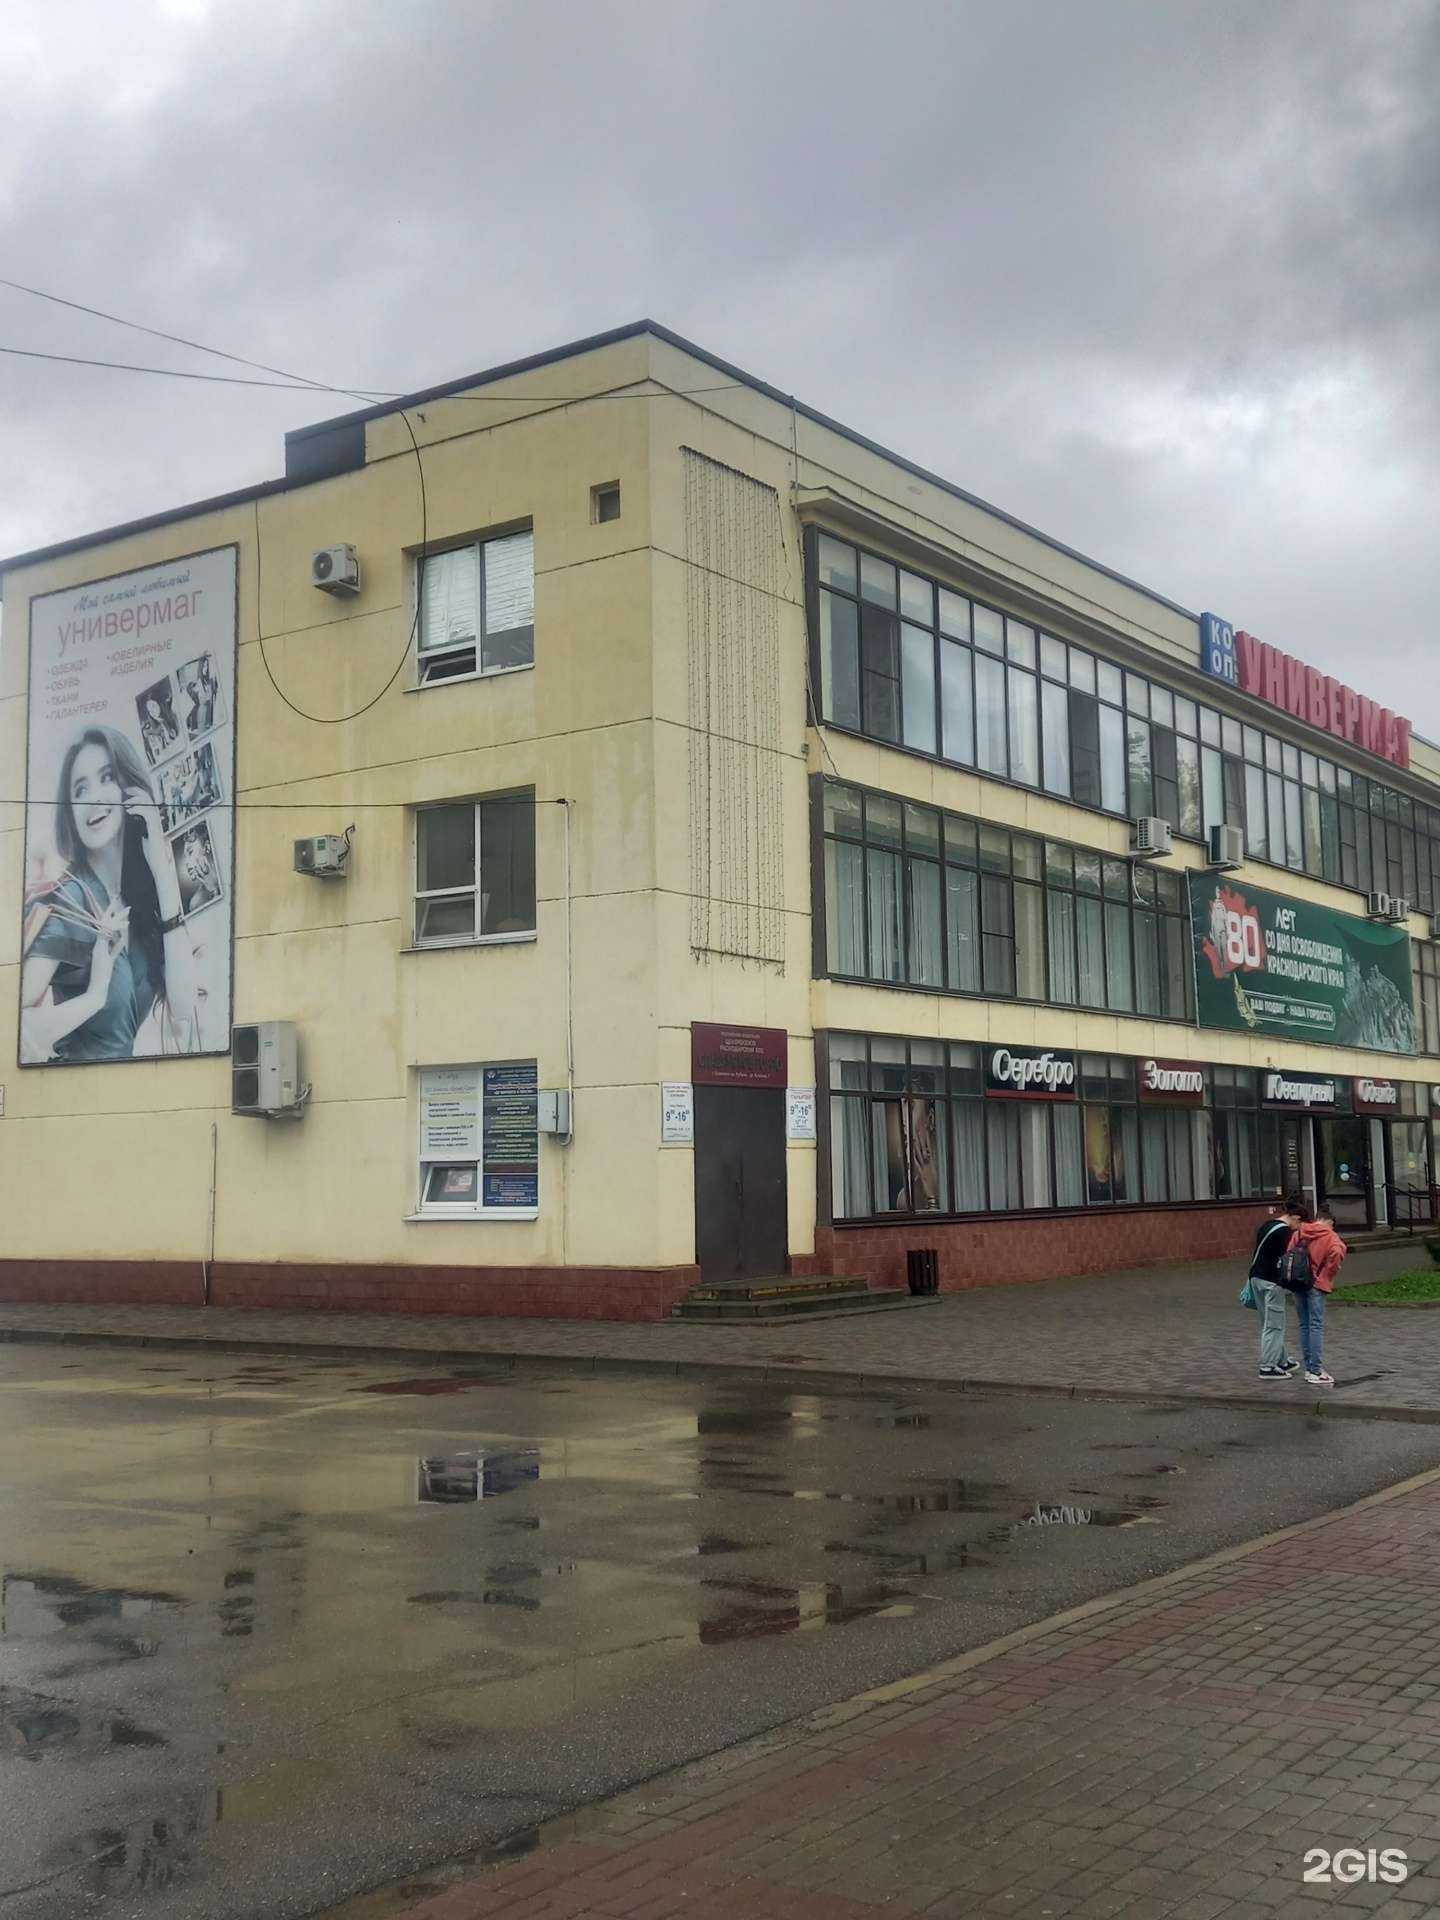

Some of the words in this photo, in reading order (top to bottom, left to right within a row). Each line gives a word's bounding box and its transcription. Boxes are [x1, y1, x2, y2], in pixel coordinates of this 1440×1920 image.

[58, 590, 203, 657] универмаг
[110, 638, 173, 662] ЮВЕЛИРНЫЕ
[50, 658, 88, 677] ОДЕЖДА
[110, 659, 154, 677] ИЗДЕЛИЯ
[50, 677, 80, 692] ОБУВЬ
[50, 692, 79, 707] ТКАНИ
[50, 700, 108, 720] ГАЛАНТЕРЕЯ
[1235, 630, 1412, 770] УНИВЕРМАГ
[1226, 910, 1261, 968] 80
[1267, 954, 1328, 985] КРАСНОДАРСКОГО
[992, 1049, 1074, 1091] Серебро
[1143, 1060, 1203, 1092] Золото
